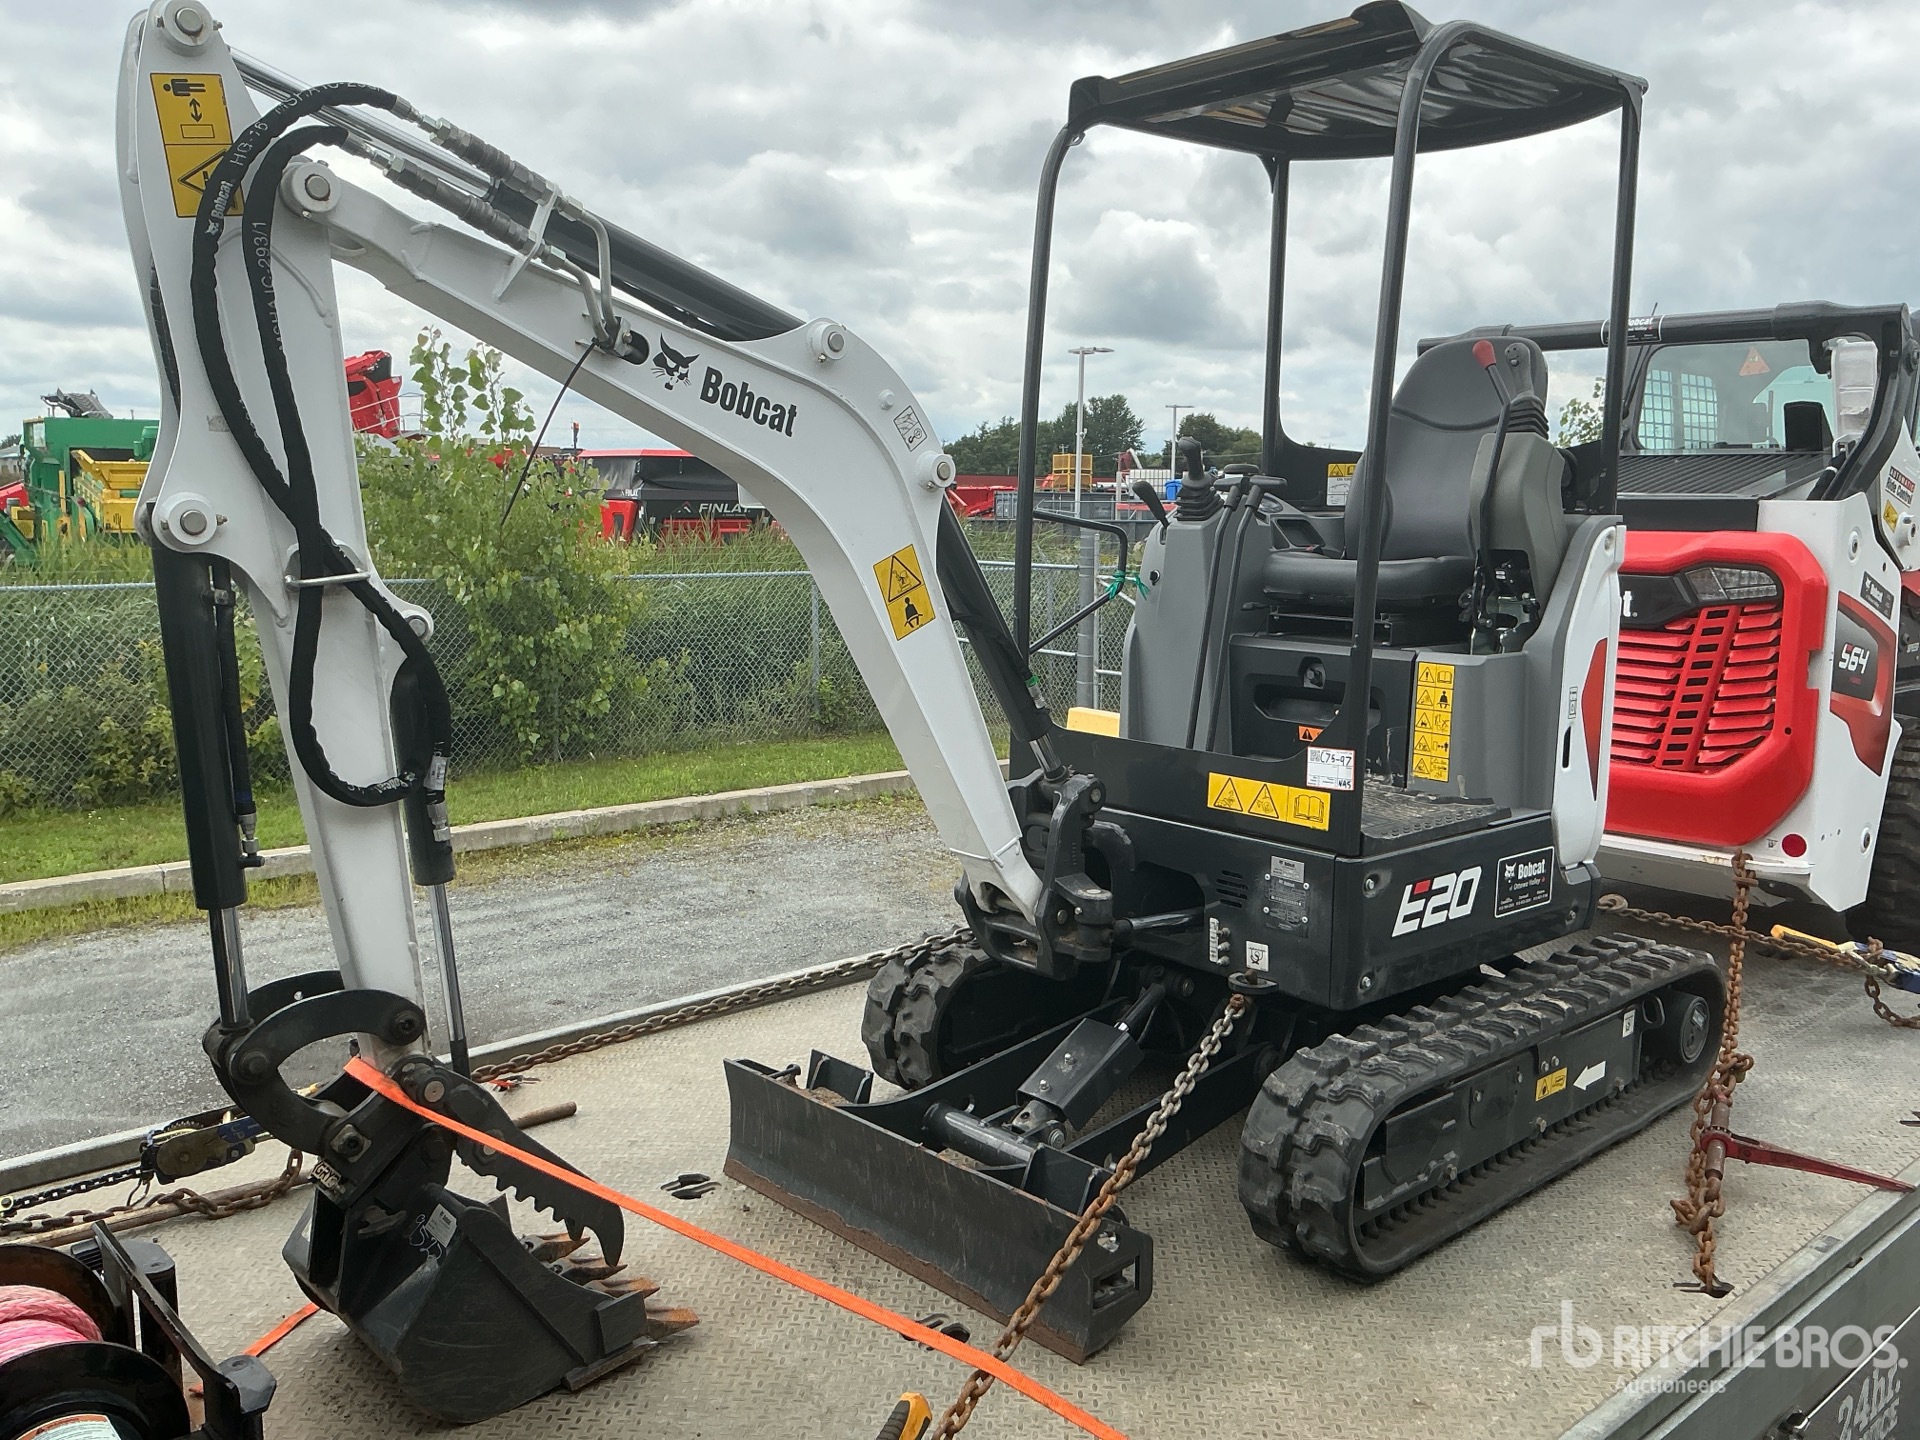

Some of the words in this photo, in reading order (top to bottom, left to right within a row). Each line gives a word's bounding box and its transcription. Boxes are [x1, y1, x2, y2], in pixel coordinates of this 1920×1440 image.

[211, 180, 234, 220] Bobcat
[700, 366, 797, 437] Bobcat
[1839, 643, 1870, 675] S64
[1518, 859, 1546, 880] Bobcat
[1392, 866, 1482, 937] E20
